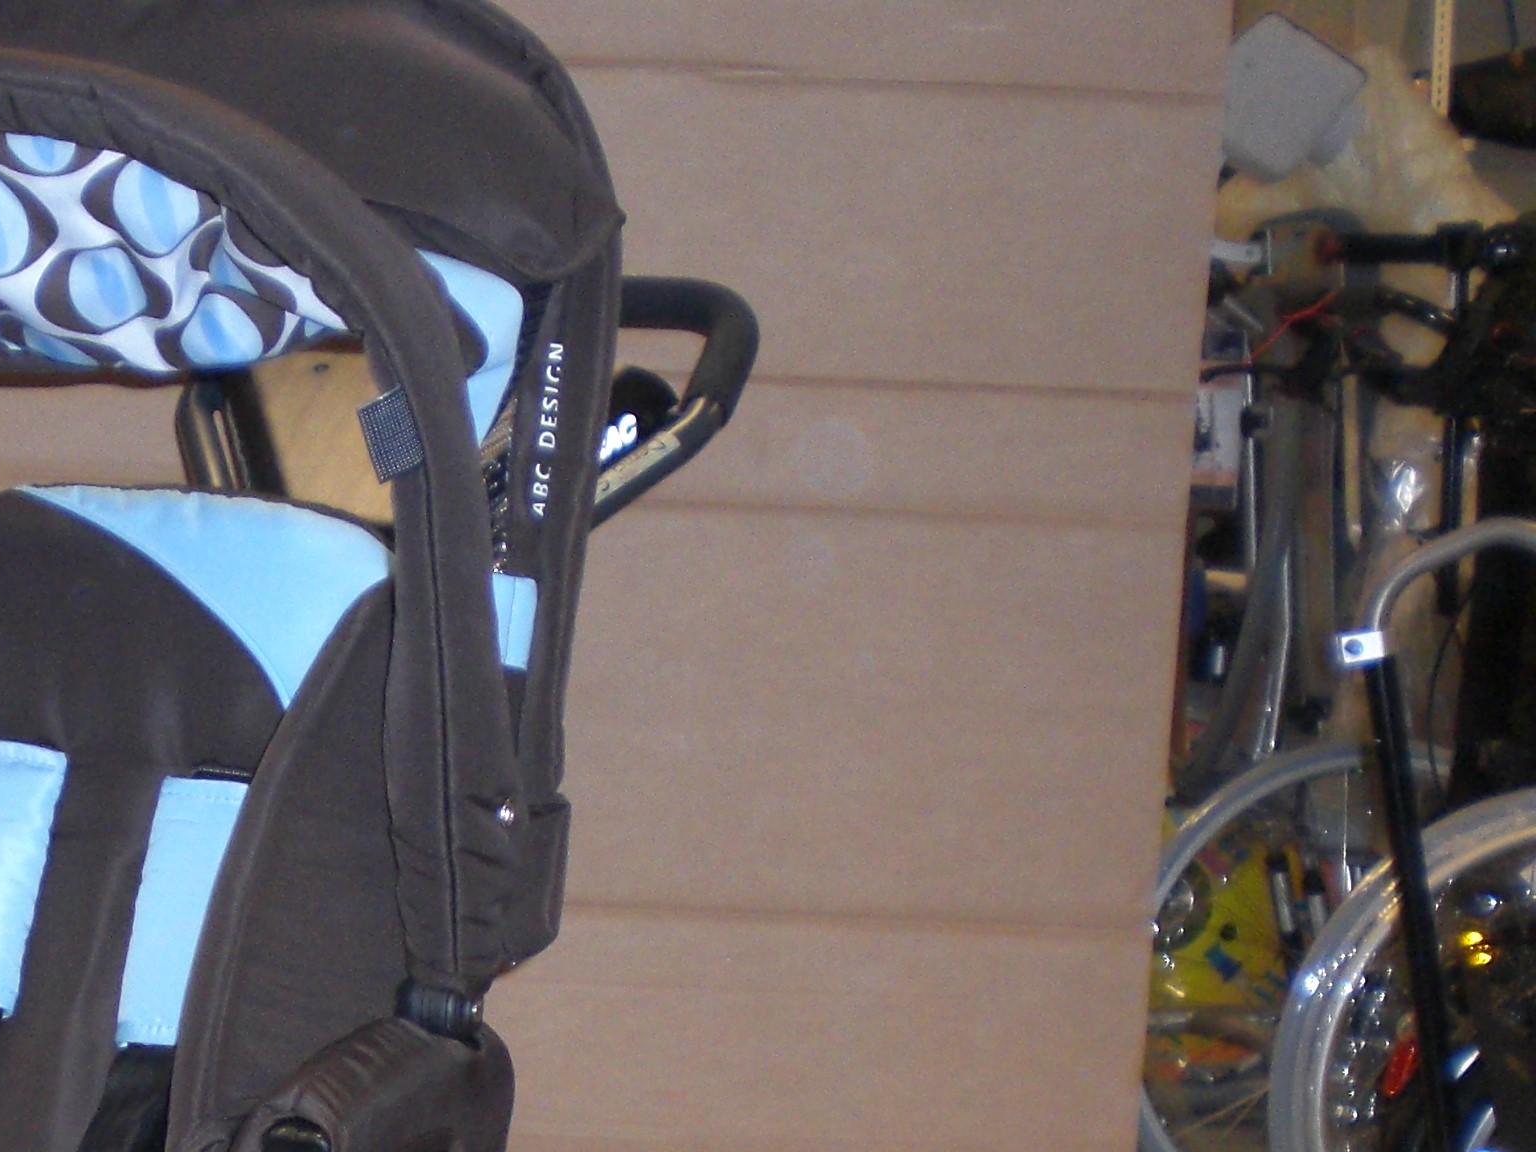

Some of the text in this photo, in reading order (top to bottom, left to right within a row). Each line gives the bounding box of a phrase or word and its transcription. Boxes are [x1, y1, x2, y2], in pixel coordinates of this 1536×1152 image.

[532, 343, 565, 517] ABC DESIGN
[599, 413, 637, 460] AC
